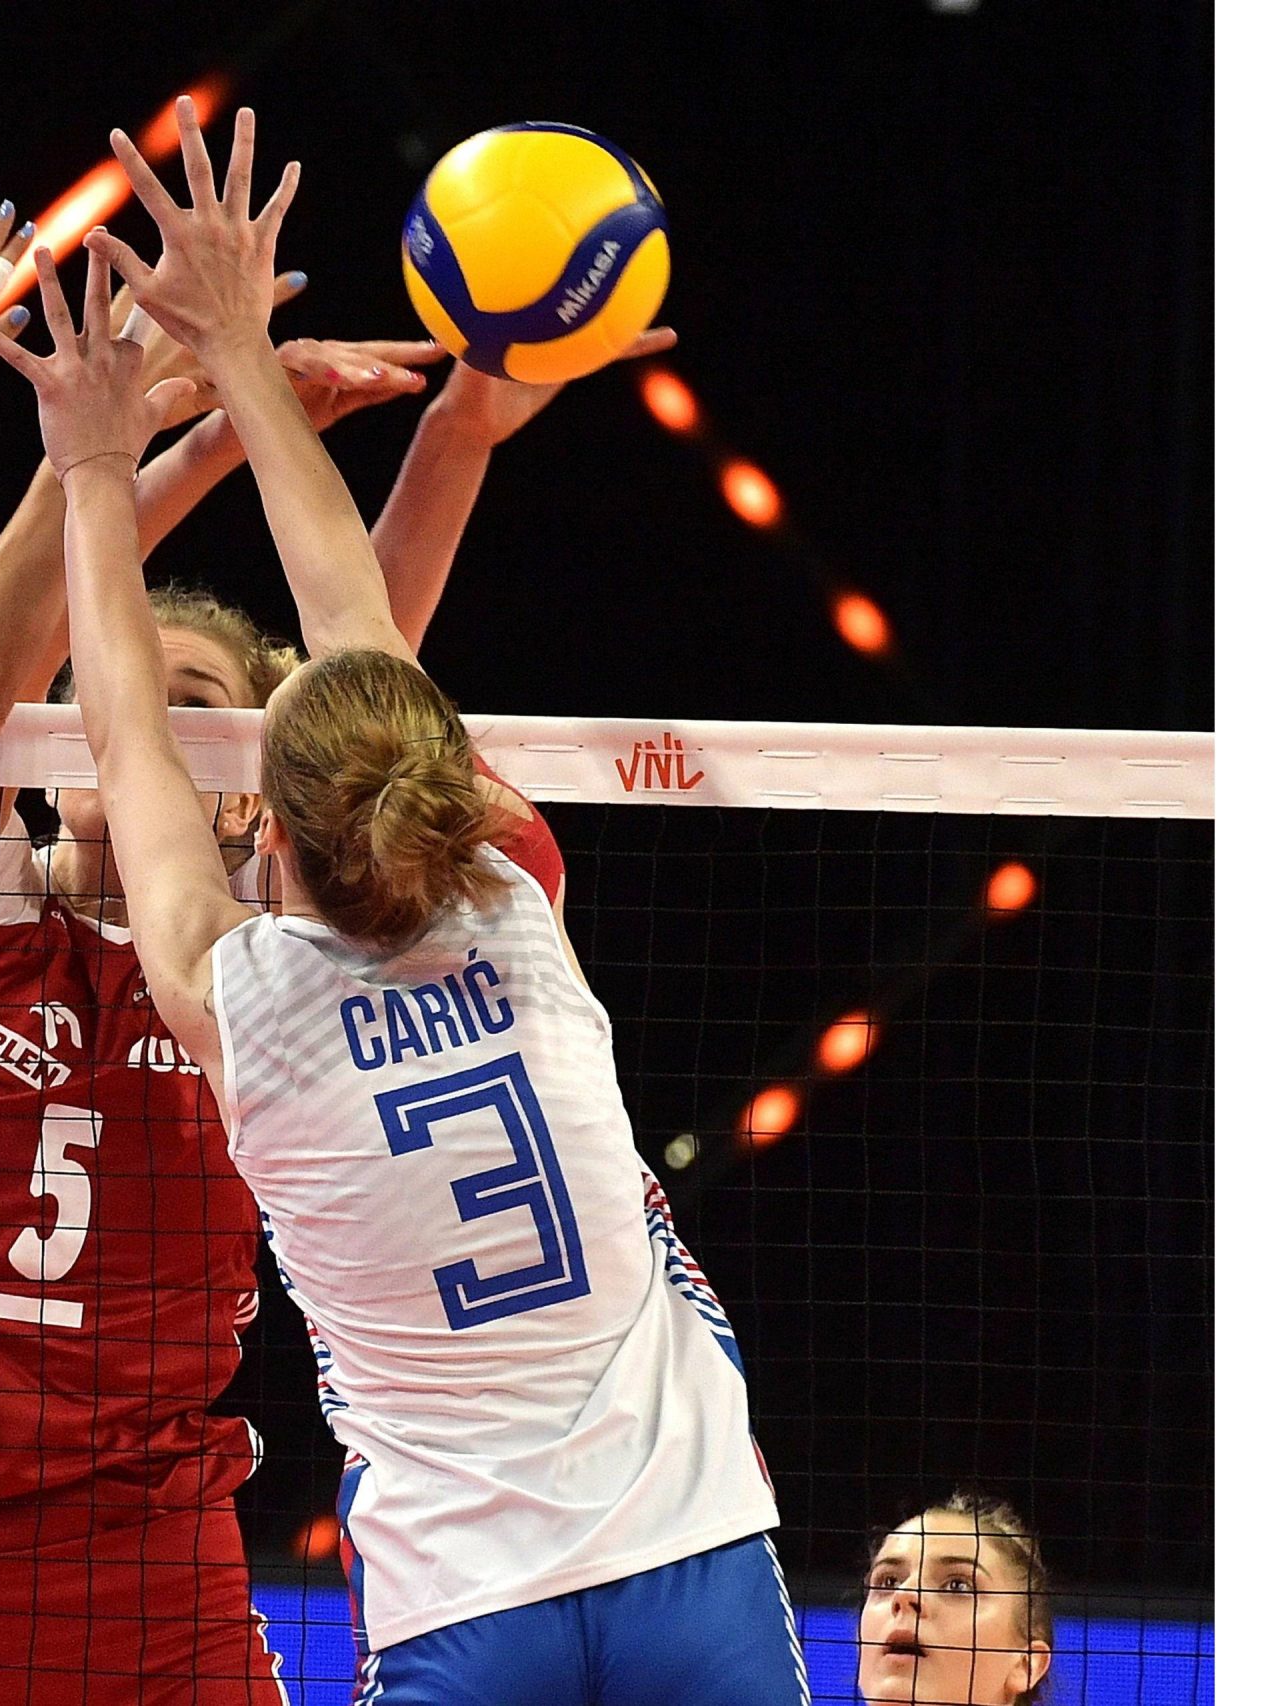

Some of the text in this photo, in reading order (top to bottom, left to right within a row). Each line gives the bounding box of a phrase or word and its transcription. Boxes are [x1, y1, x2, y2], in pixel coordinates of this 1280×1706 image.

[556, 240, 621, 325] MIKASA
[615, 732, 704, 792] VNL
[340, 948, 515, 1071] CARIĆ
[8, 1103, 104, 1281] 5
[373, 1051, 592, 1331] 3
